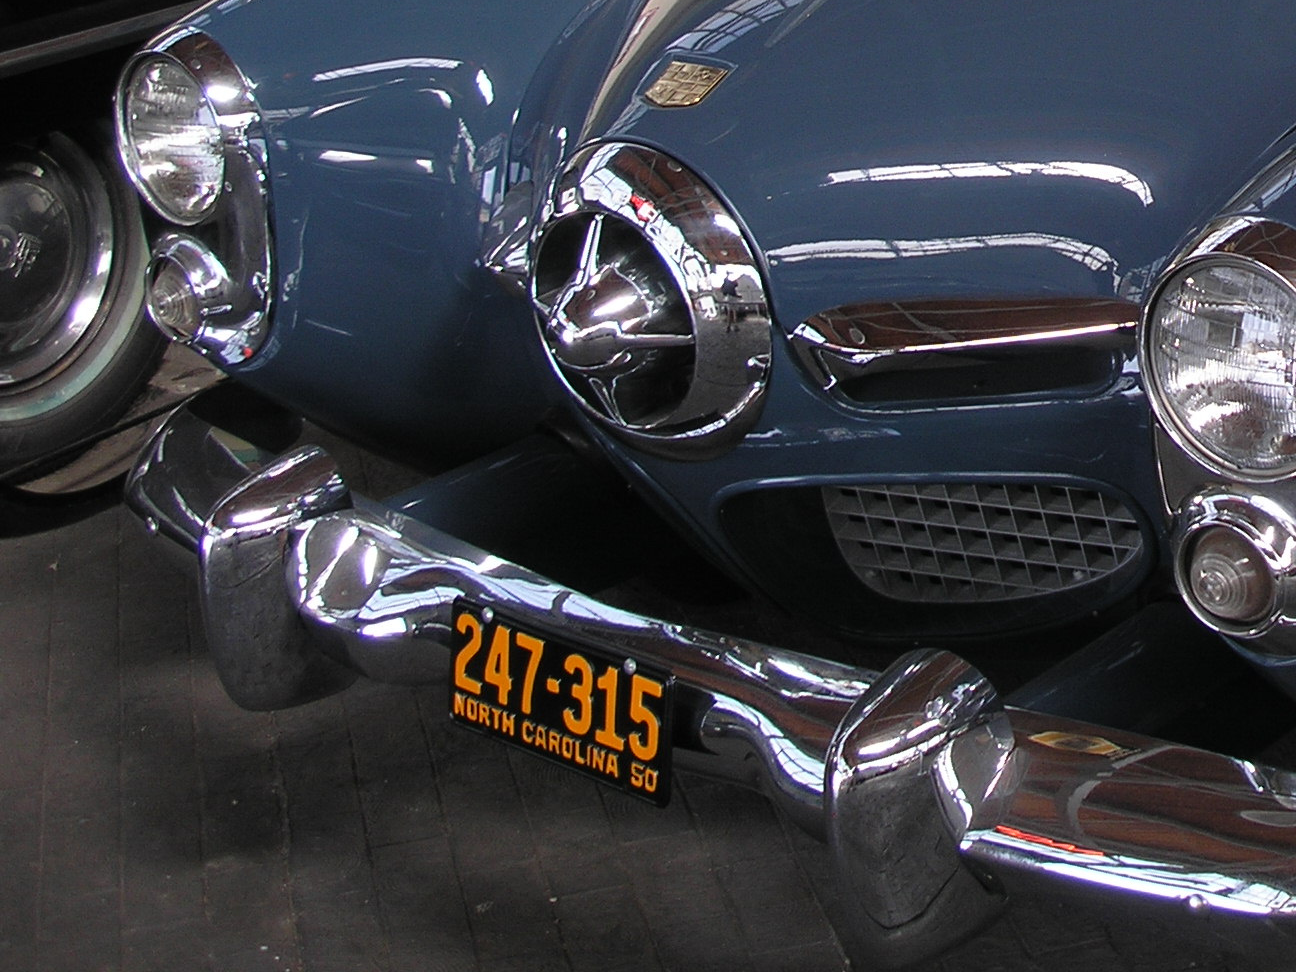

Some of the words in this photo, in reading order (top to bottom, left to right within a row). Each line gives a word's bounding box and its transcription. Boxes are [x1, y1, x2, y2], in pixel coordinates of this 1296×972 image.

[454, 693, 516, 736] NORTH
[522, 721, 619, 778] CAROLINA
[630, 763, 659, 793] 50
[455, 613, 663, 761] 247-315
